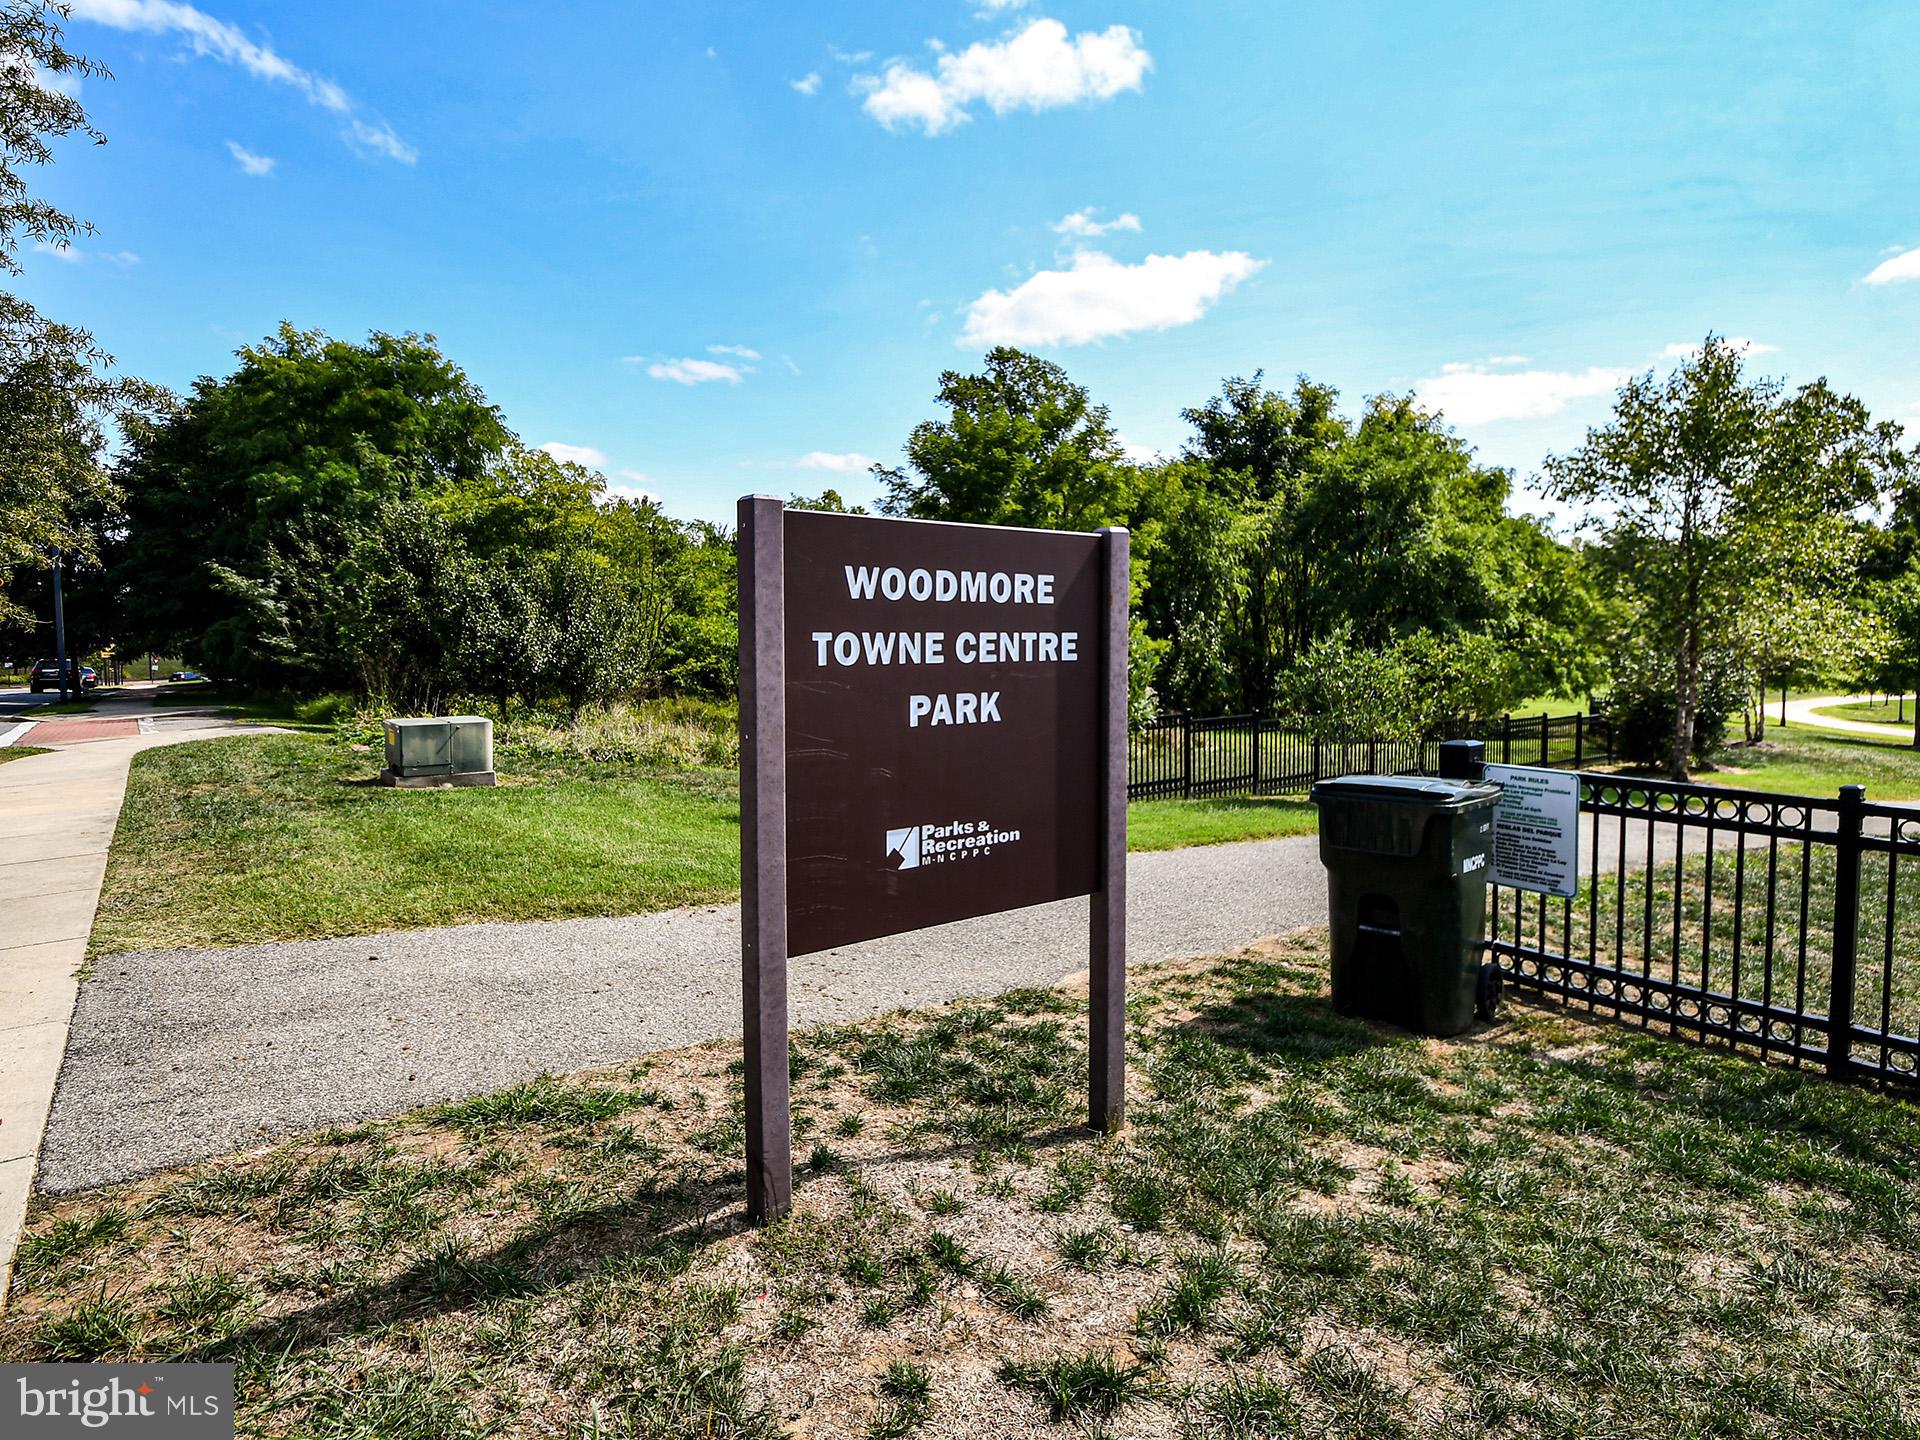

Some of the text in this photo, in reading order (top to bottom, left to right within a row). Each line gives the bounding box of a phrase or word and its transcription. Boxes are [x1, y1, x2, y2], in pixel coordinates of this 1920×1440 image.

[844, 565, 1055, 605] WOODMORE
[811, 631, 1079, 667] TOWNE CENTRE
[909, 691, 1002, 728] PARK
[921, 820, 990, 840] Parks &
[921, 829, 1020, 856] Recreation
